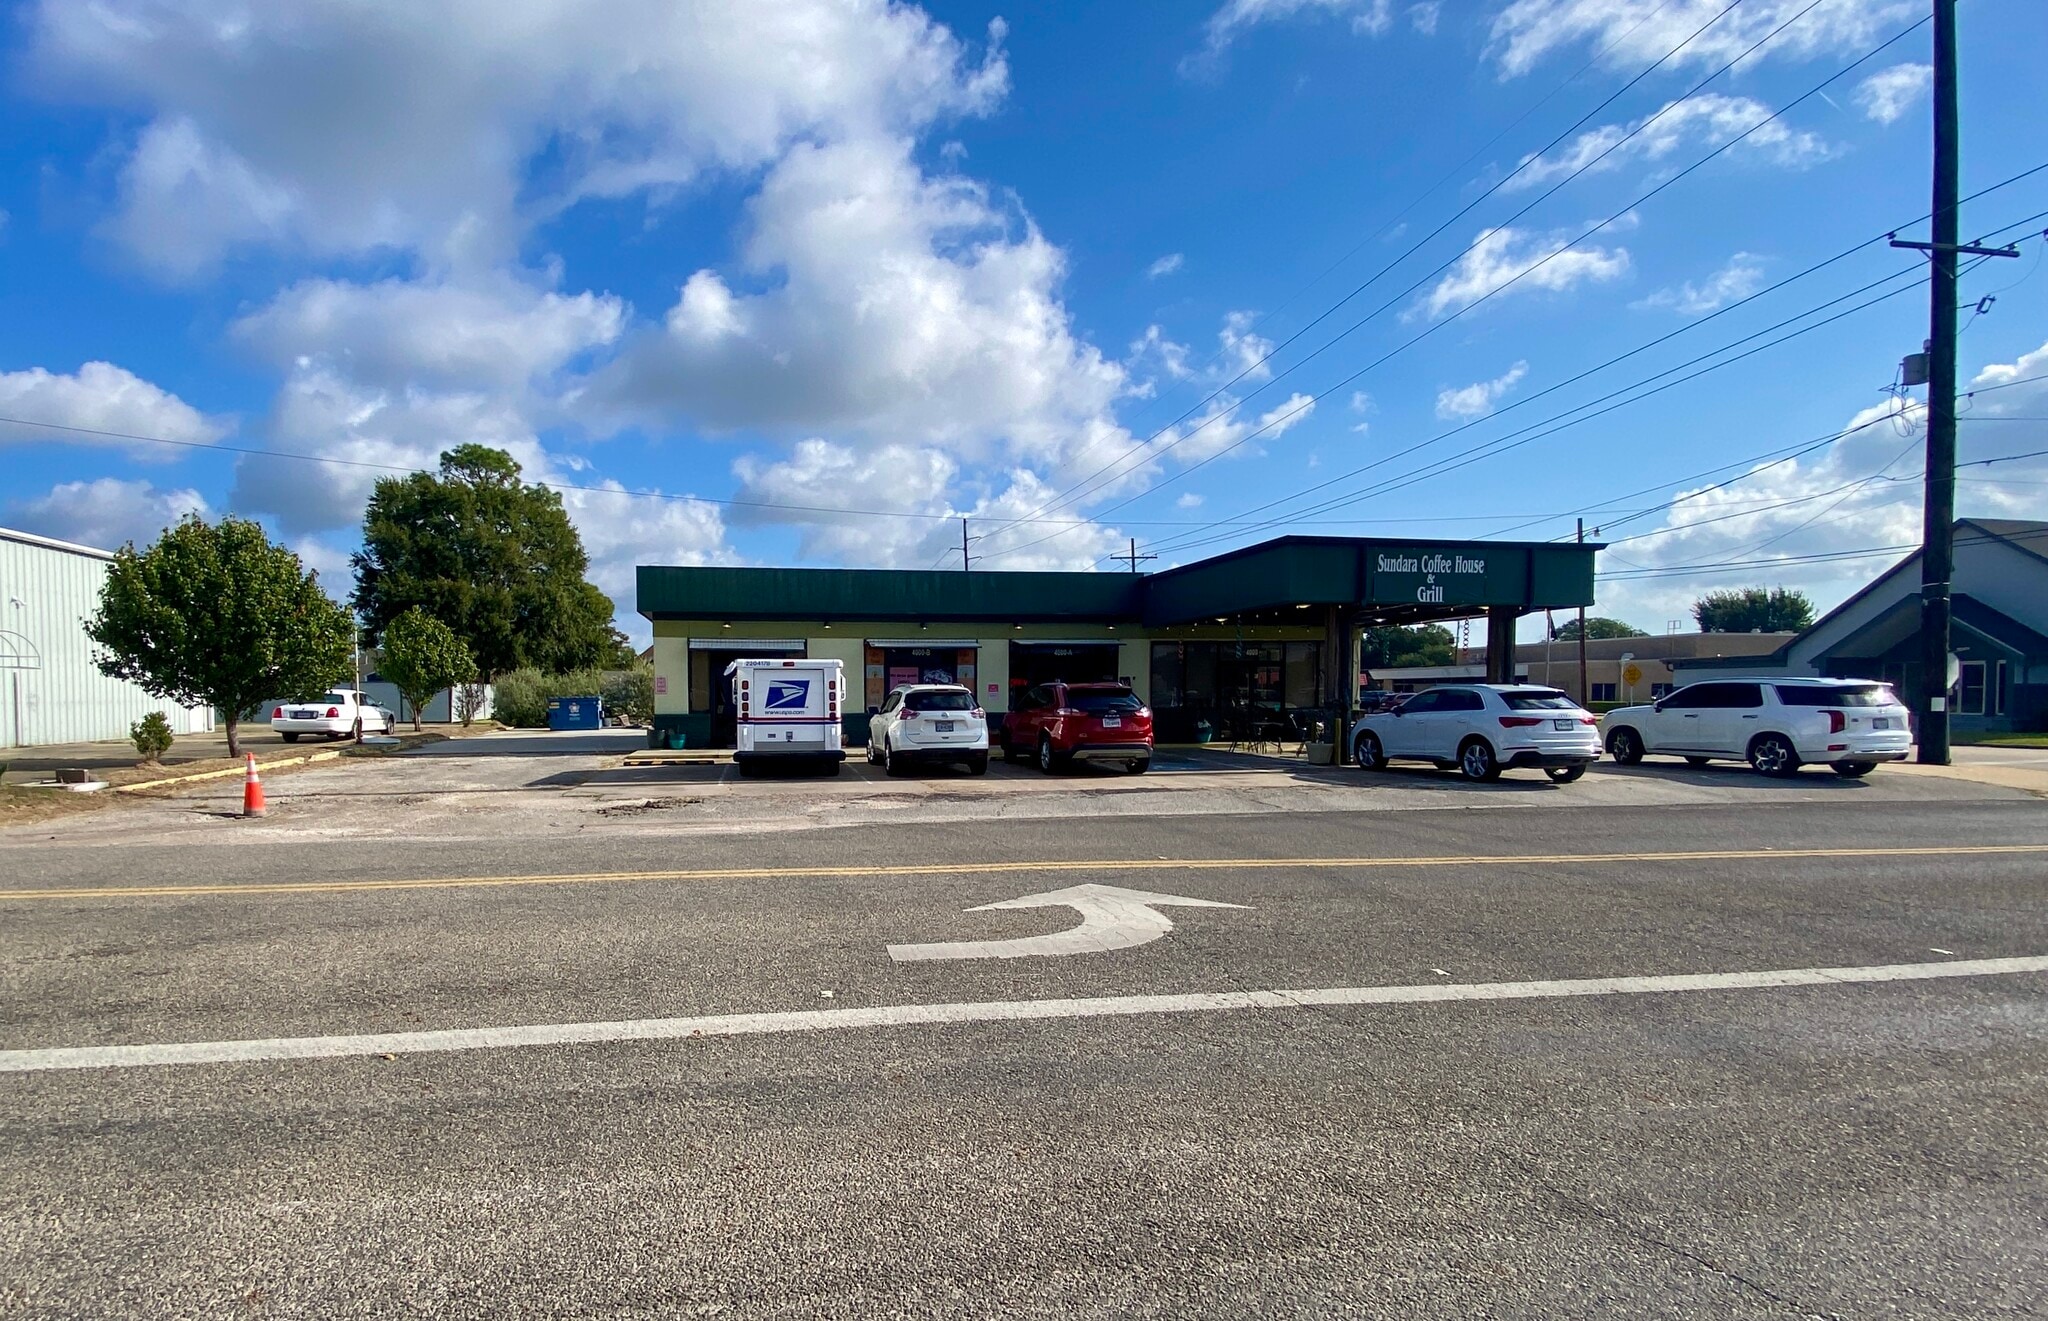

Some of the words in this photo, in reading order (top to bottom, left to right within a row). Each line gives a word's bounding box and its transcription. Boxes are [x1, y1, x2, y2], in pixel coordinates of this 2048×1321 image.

[1377, 553, 1418, 573] Sundara
[1421, 554, 1452, 573] Coffee
[1454, 555, 1485, 574] House
[1426, 573, 1436, 584] &
[1416, 585, 1445, 603] Grill
